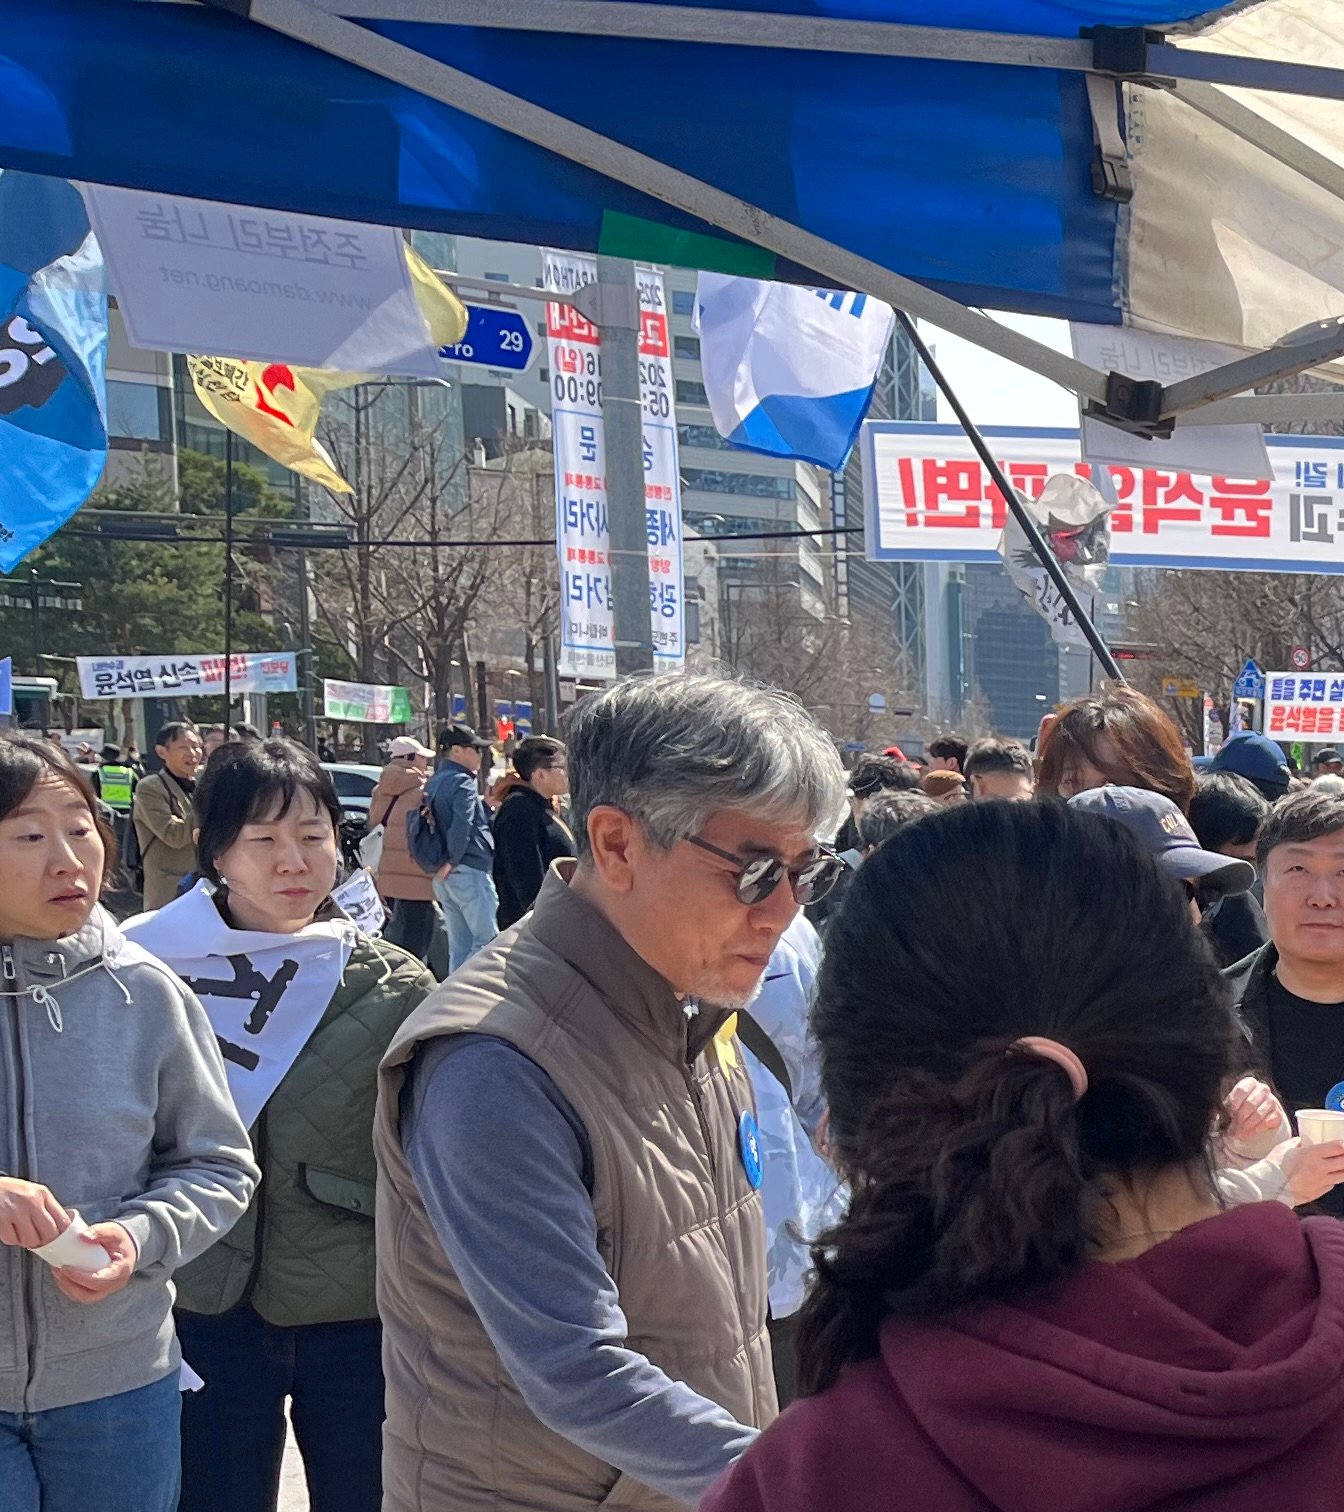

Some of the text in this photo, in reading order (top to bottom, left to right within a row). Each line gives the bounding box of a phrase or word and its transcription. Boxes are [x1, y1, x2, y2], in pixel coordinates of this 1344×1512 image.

[499, 330, 523, 352] 29
[96, 667, 156, 697] 윤석열
[159, 661, 200, 689] 신속
[1271, 678, 1296, 701] 틈을
[1300, 678, 1326, 702] 주면
[1270, 705, 1334, 733] 윤석열을
